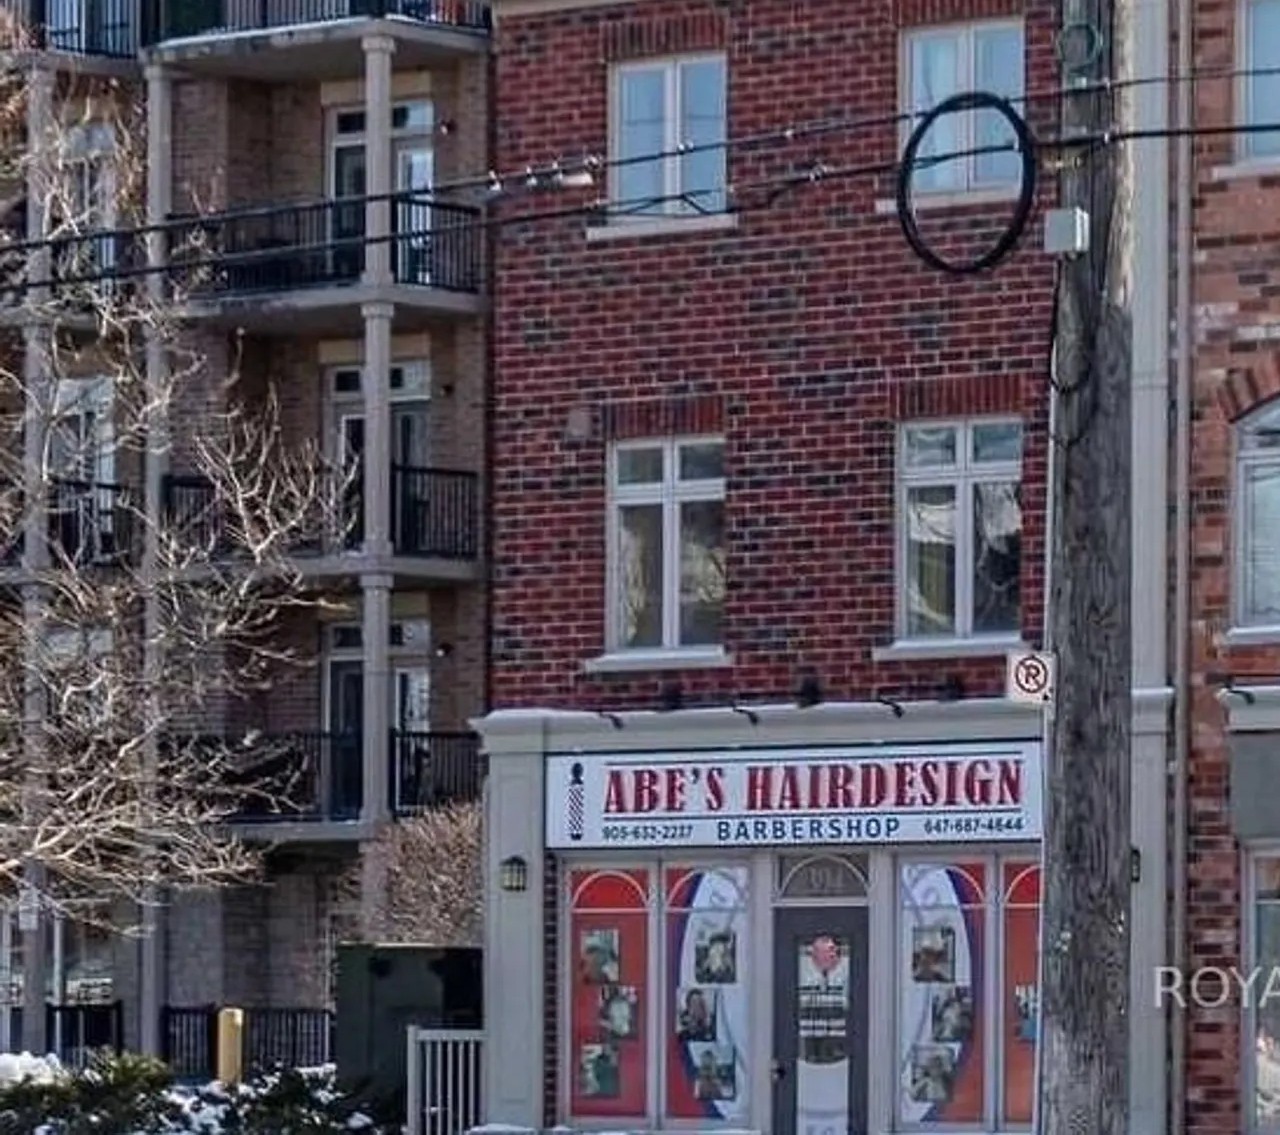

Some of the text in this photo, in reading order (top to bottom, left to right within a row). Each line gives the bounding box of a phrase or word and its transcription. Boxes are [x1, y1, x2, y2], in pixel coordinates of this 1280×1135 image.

[604, 759, 1023, 813] ABE'S HAIRDESIGN
[717, 817, 900, 841] BARBERSHOP
